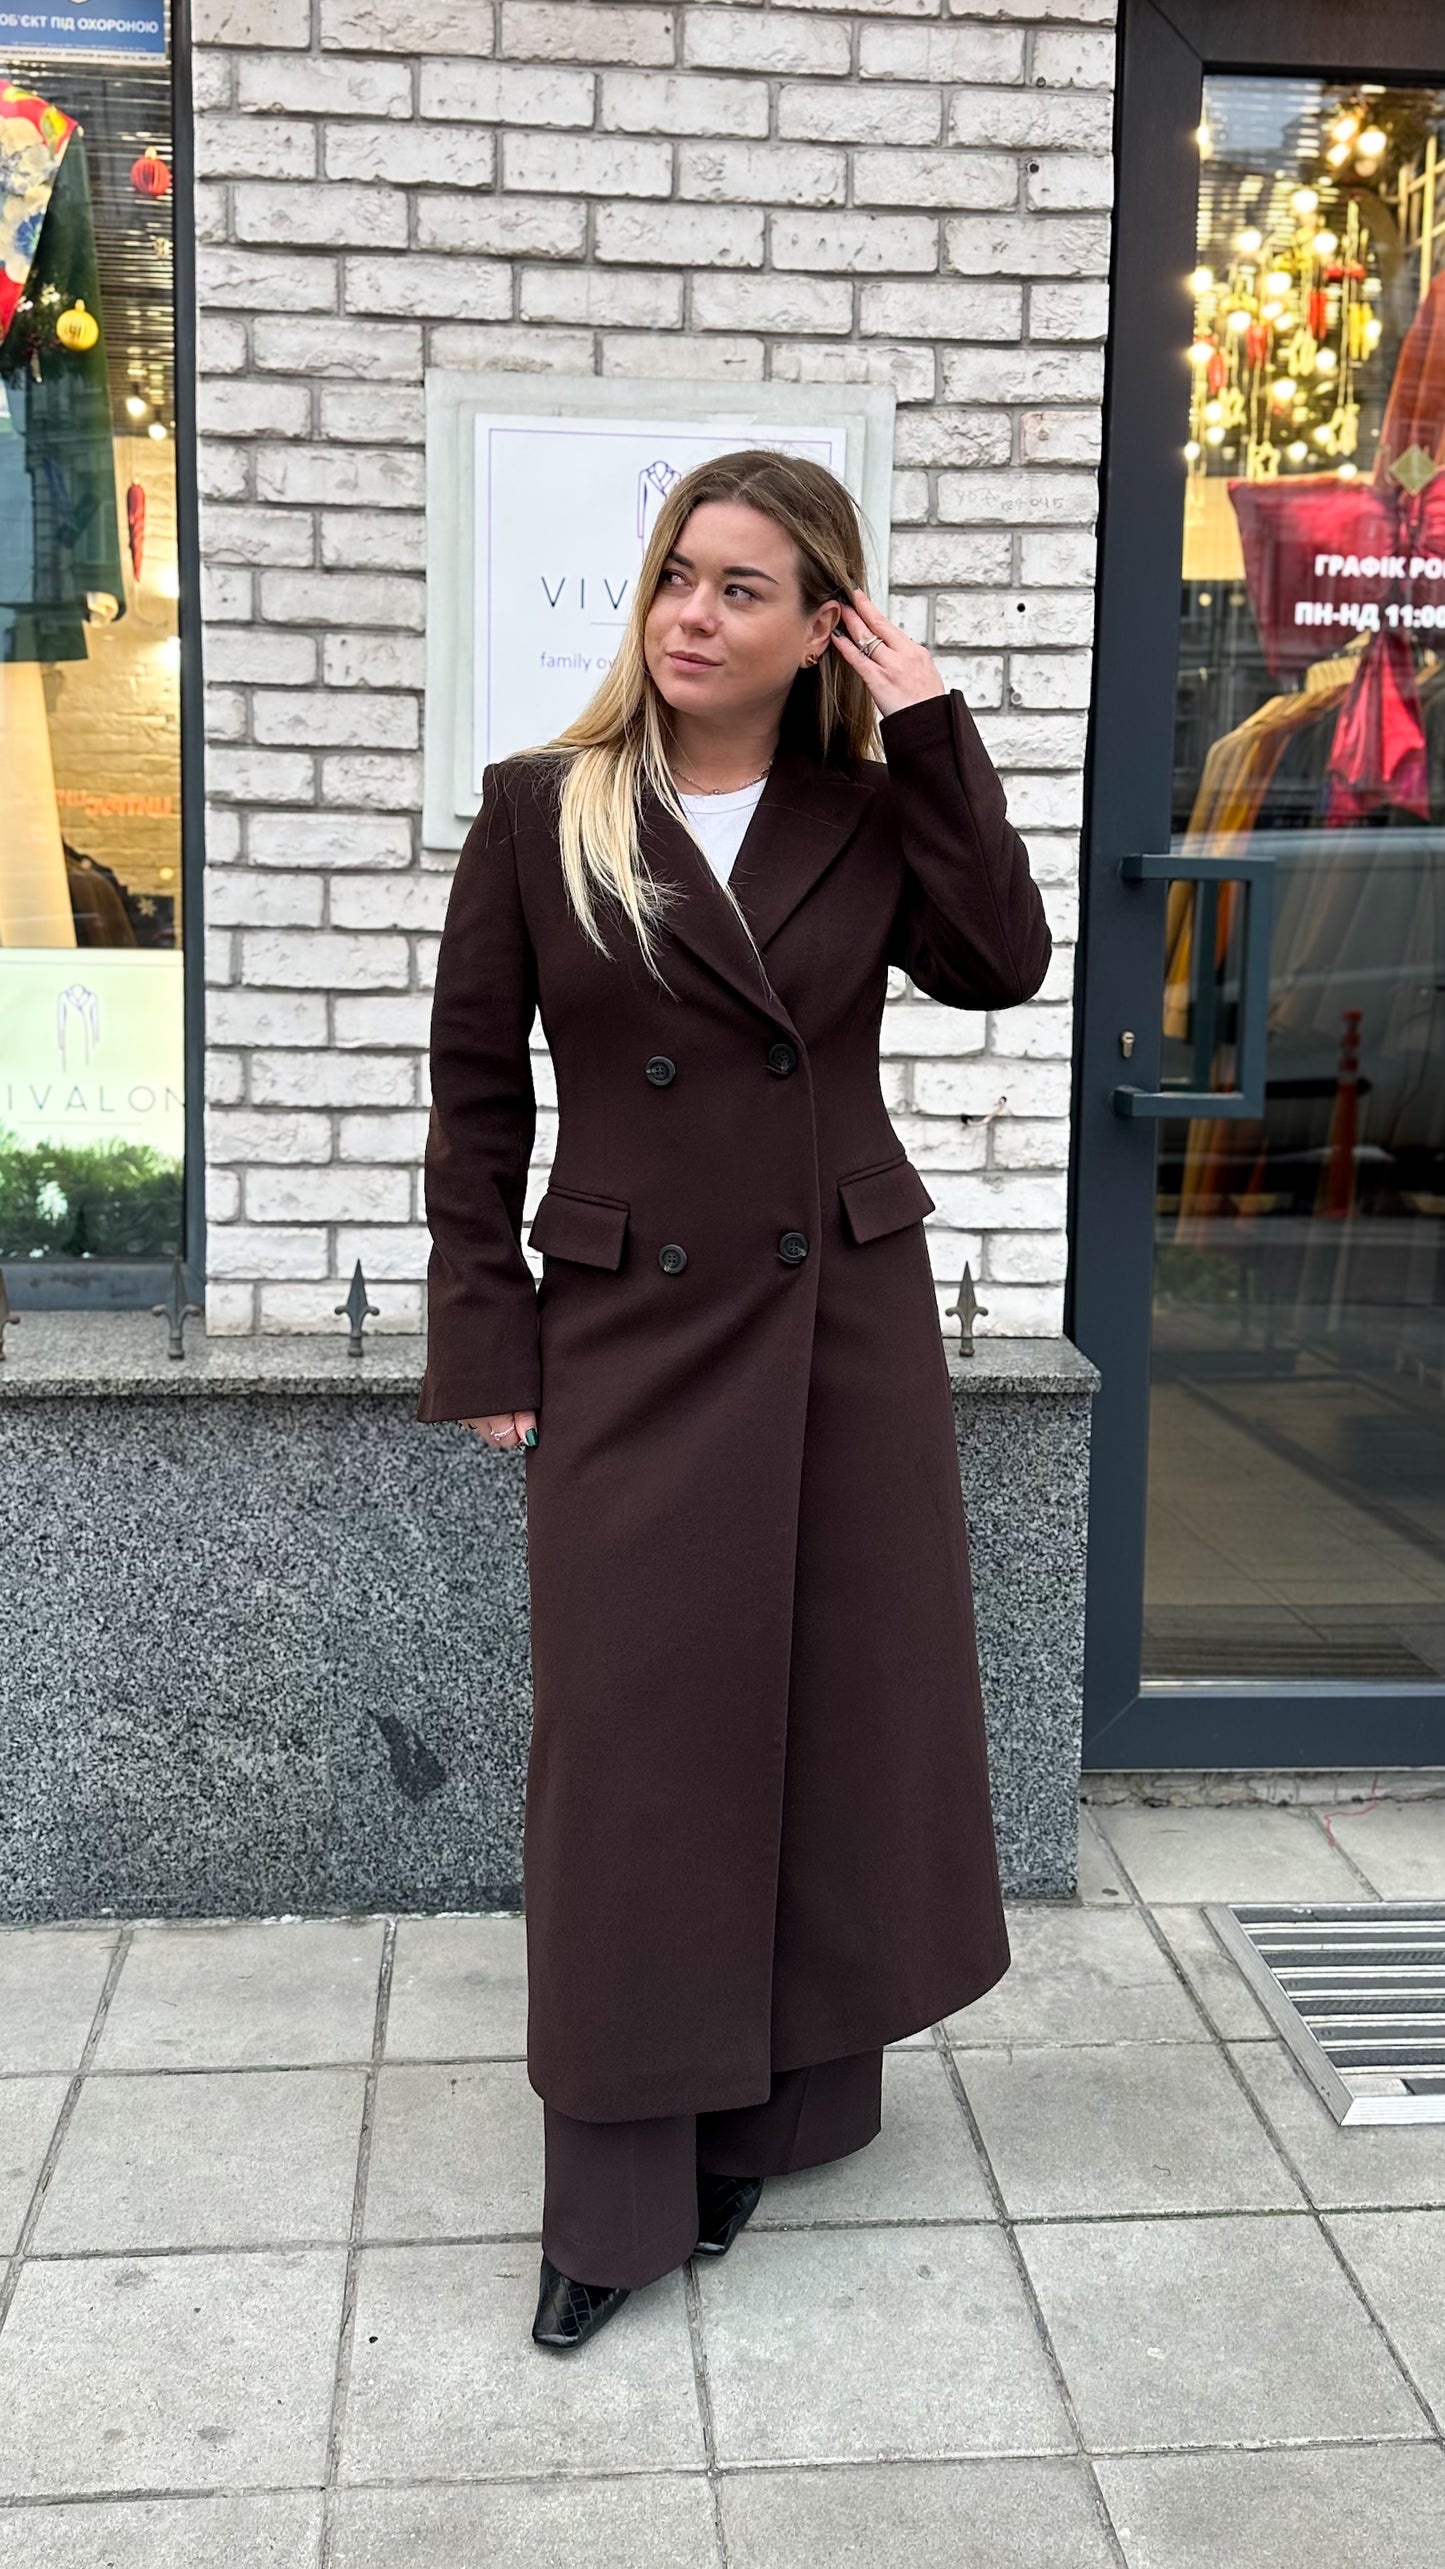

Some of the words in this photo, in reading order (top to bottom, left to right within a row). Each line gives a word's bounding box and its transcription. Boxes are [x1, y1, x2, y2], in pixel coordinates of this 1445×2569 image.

[50, 16, 75, 31] ПІД
[77, 18, 159, 33] ОХОРОНОЮ
[1314, 554, 1407, 578] ГРАФІК
[1409, 556, 1445, 579] РО
[1294, 601, 1381, 632] ПН-НД
[1384, 603, 1445, 629] 11:00
[540, 651, 591, 671] family
